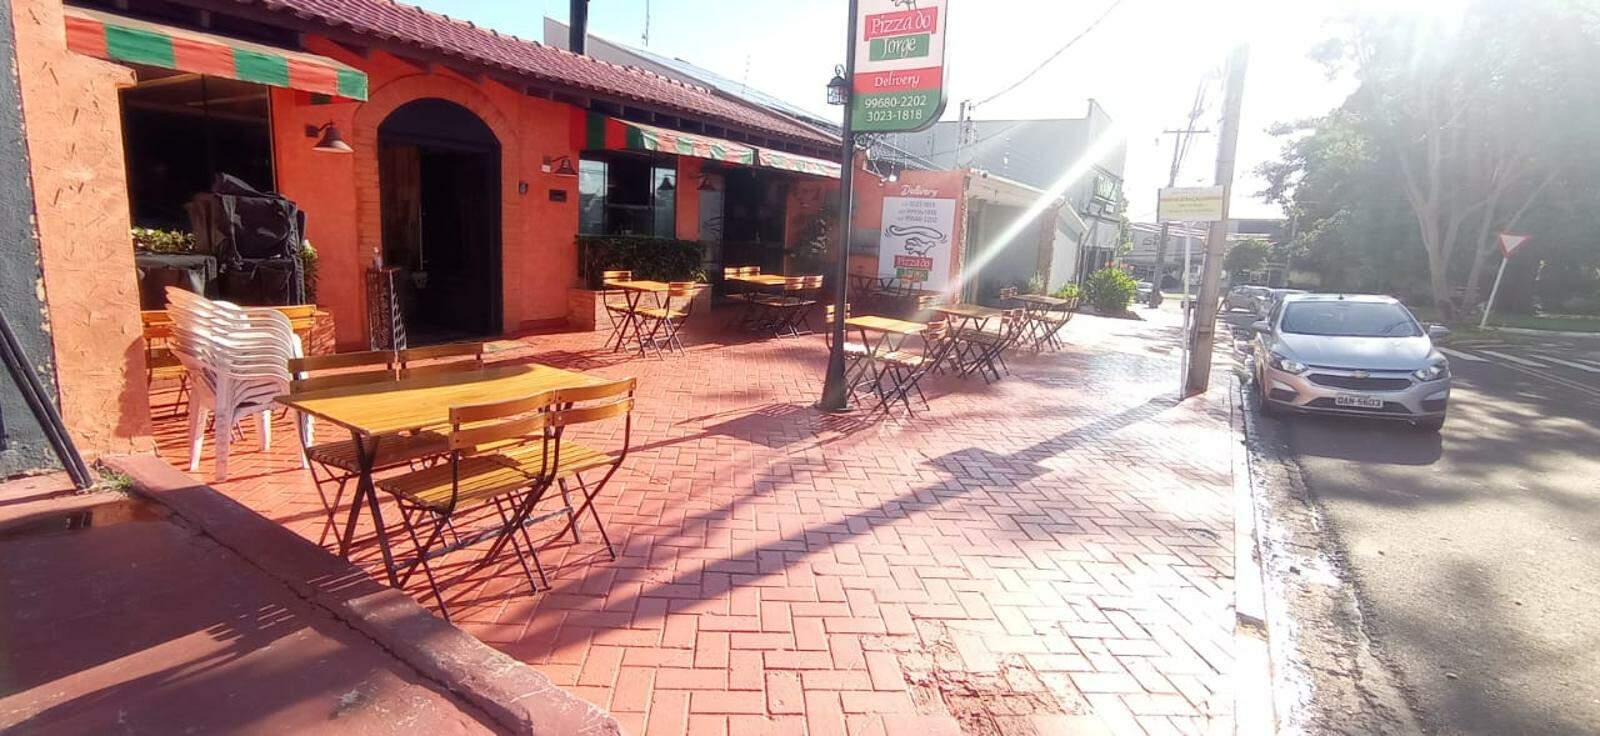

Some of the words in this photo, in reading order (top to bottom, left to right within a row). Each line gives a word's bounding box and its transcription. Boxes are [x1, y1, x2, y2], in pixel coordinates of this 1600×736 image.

[871, 14, 912, 34] Pizza
[915, 10, 931, 29] do
[881, 38, 916, 57] Jorge
[874, 71, 920, 88] Delivery
[864, 95, 927, 109] 99680-2202
[866, 109, 922, 122] 3023-1818
